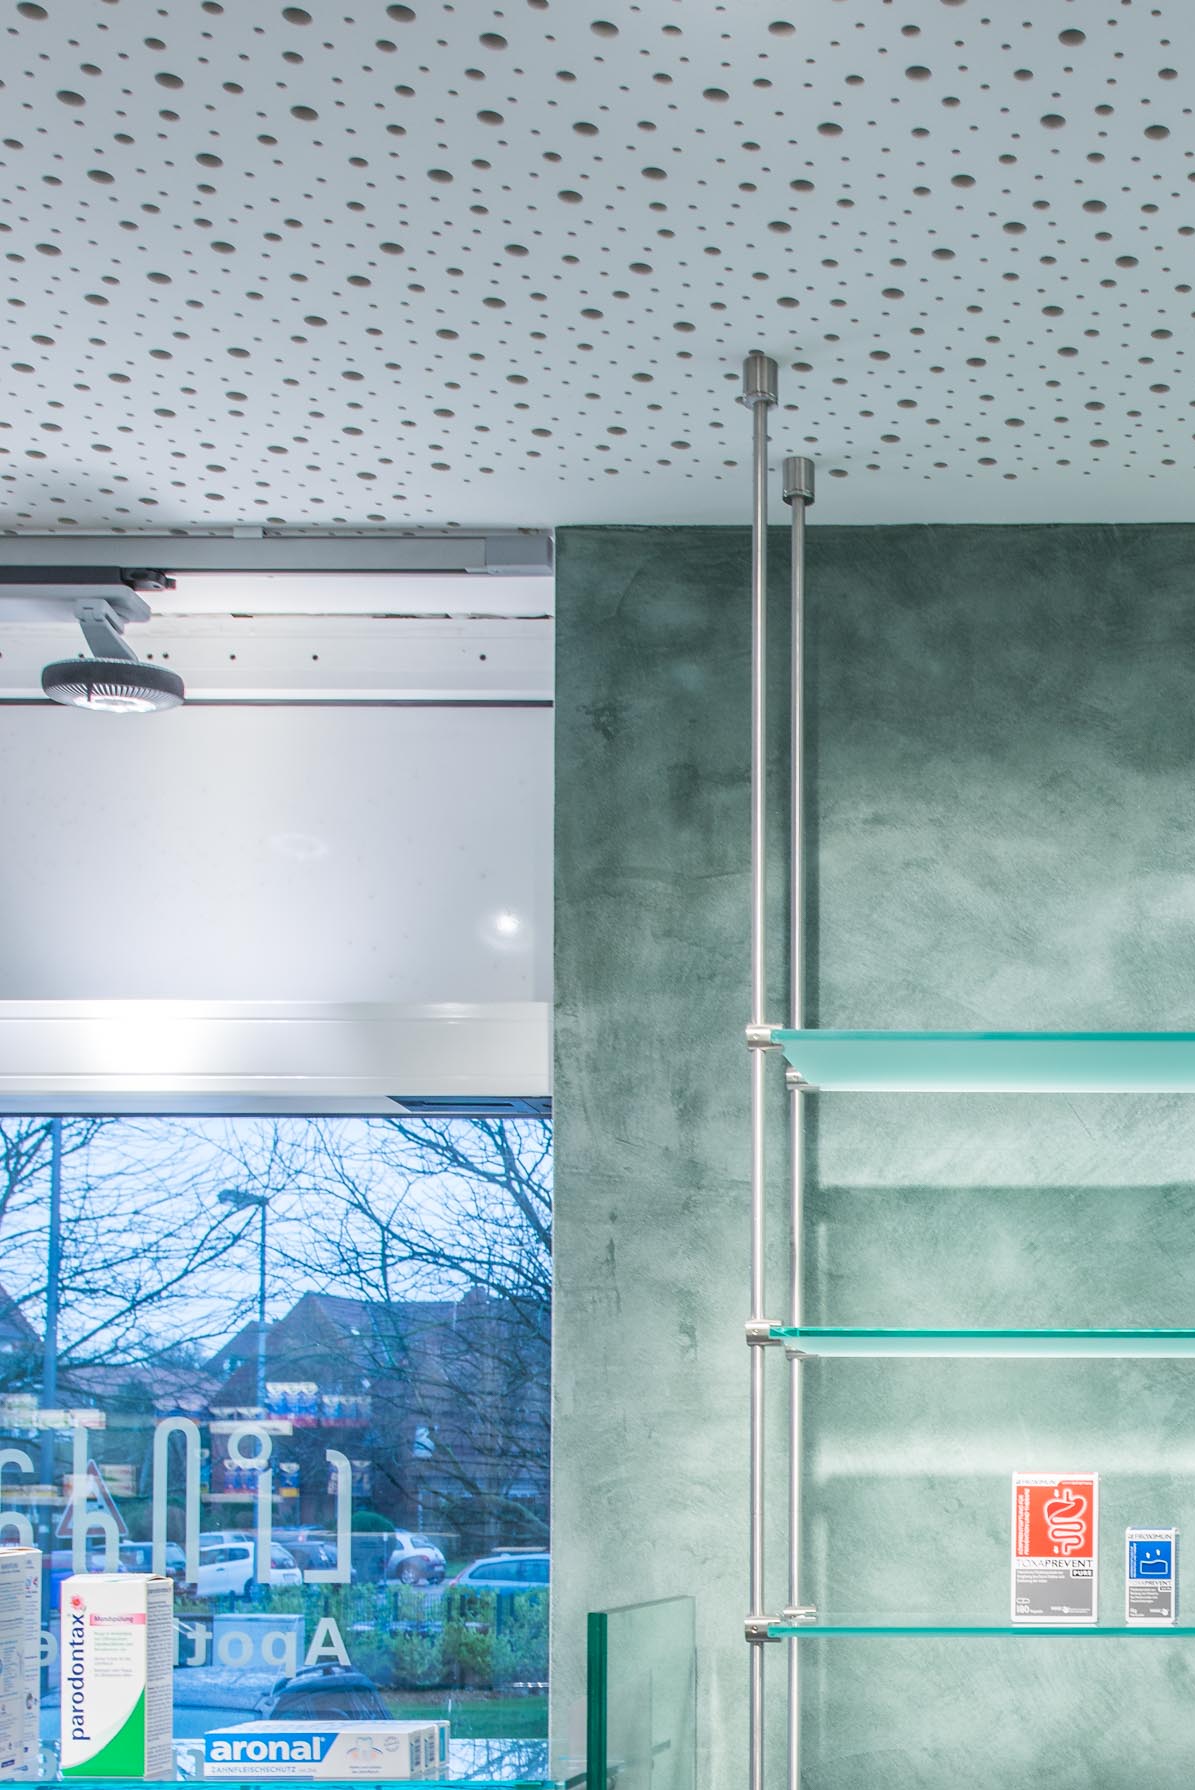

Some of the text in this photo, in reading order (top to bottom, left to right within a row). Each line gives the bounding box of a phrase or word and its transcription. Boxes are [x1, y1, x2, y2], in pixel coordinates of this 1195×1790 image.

[67, 1613, 91, 1741] parodontax
[210, 1736, 322, 1762] aronal
[210, 1765, 297, 1774] ZAHNFLEISCHSCHUTZ
